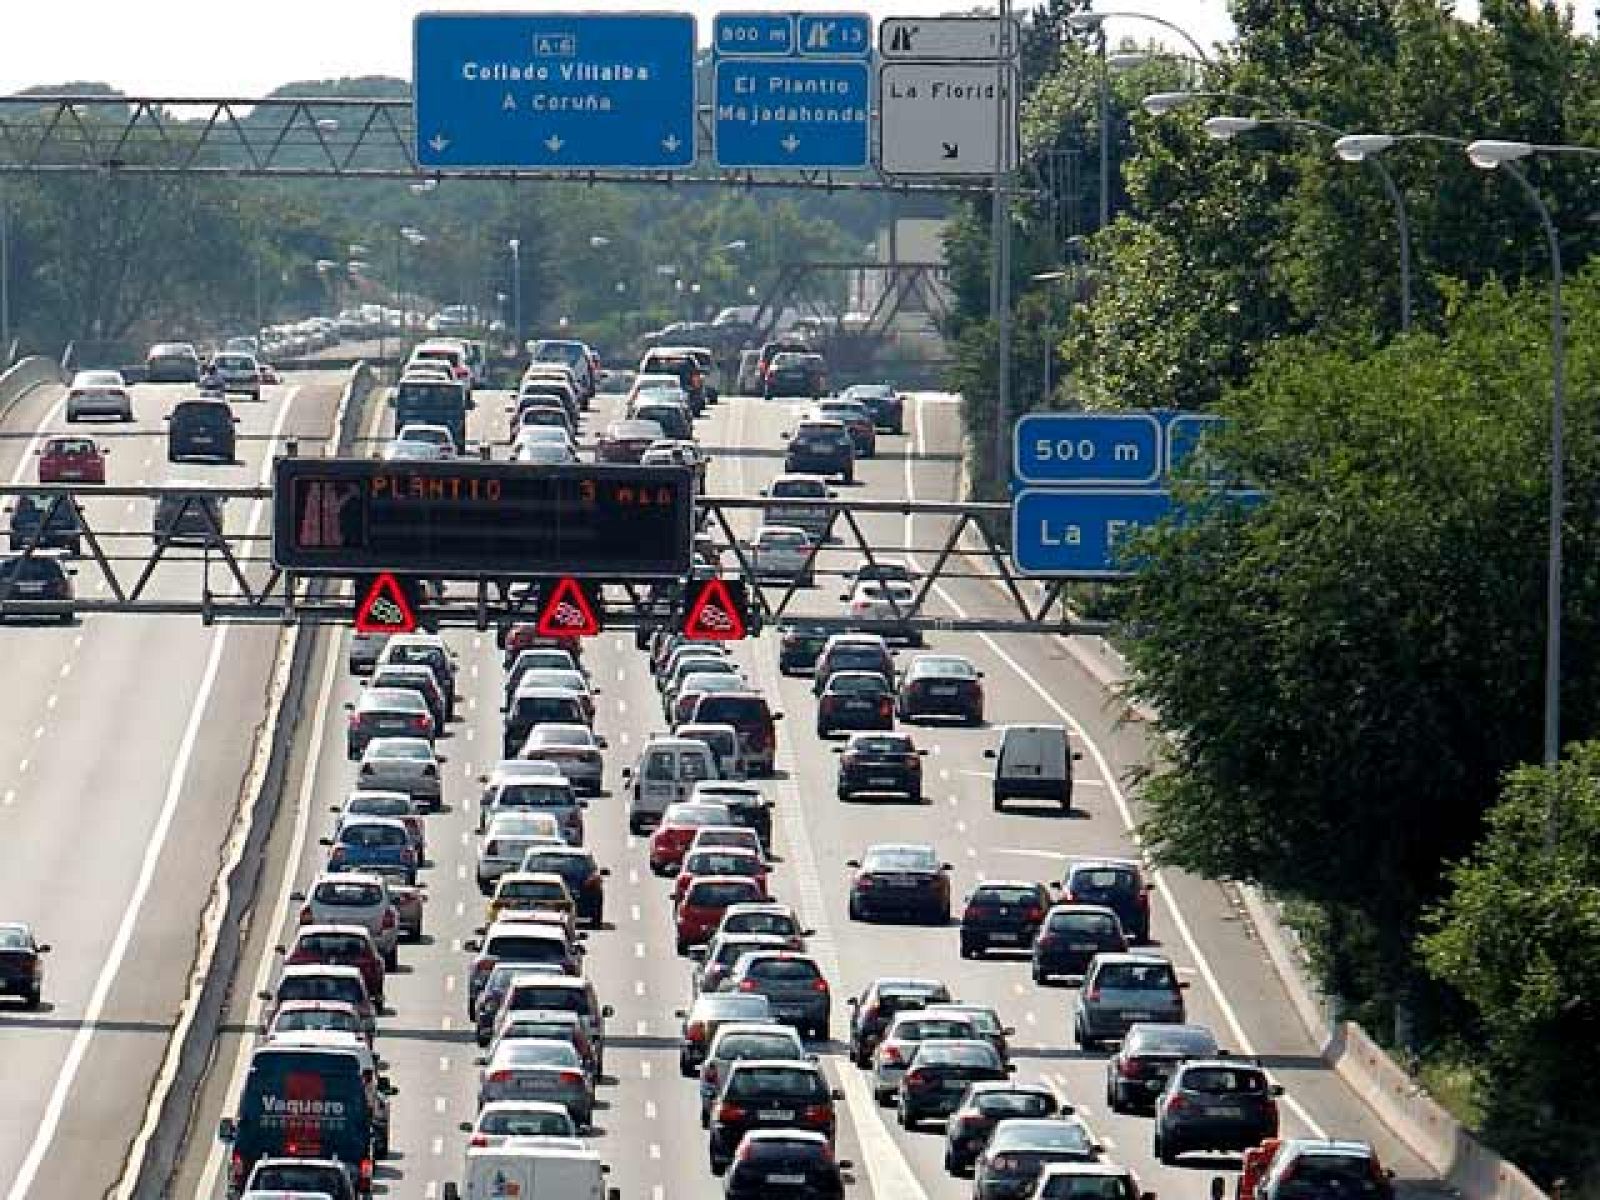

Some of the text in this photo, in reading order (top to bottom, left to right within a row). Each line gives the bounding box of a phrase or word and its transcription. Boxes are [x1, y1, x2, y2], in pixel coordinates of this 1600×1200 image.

[769, 29, 786, 41] m
[462, 62, 649, 81] Collado Villalba
[734, 76, 756, 94] El
[890, 82, 916, 98] La
[502, 92, 611, 111] A Coruña
[719, 105, 866, 124] Majadahonda
[1036, 440, 1138, 460] 500 m
[1040, 519, 1081, 546] La
